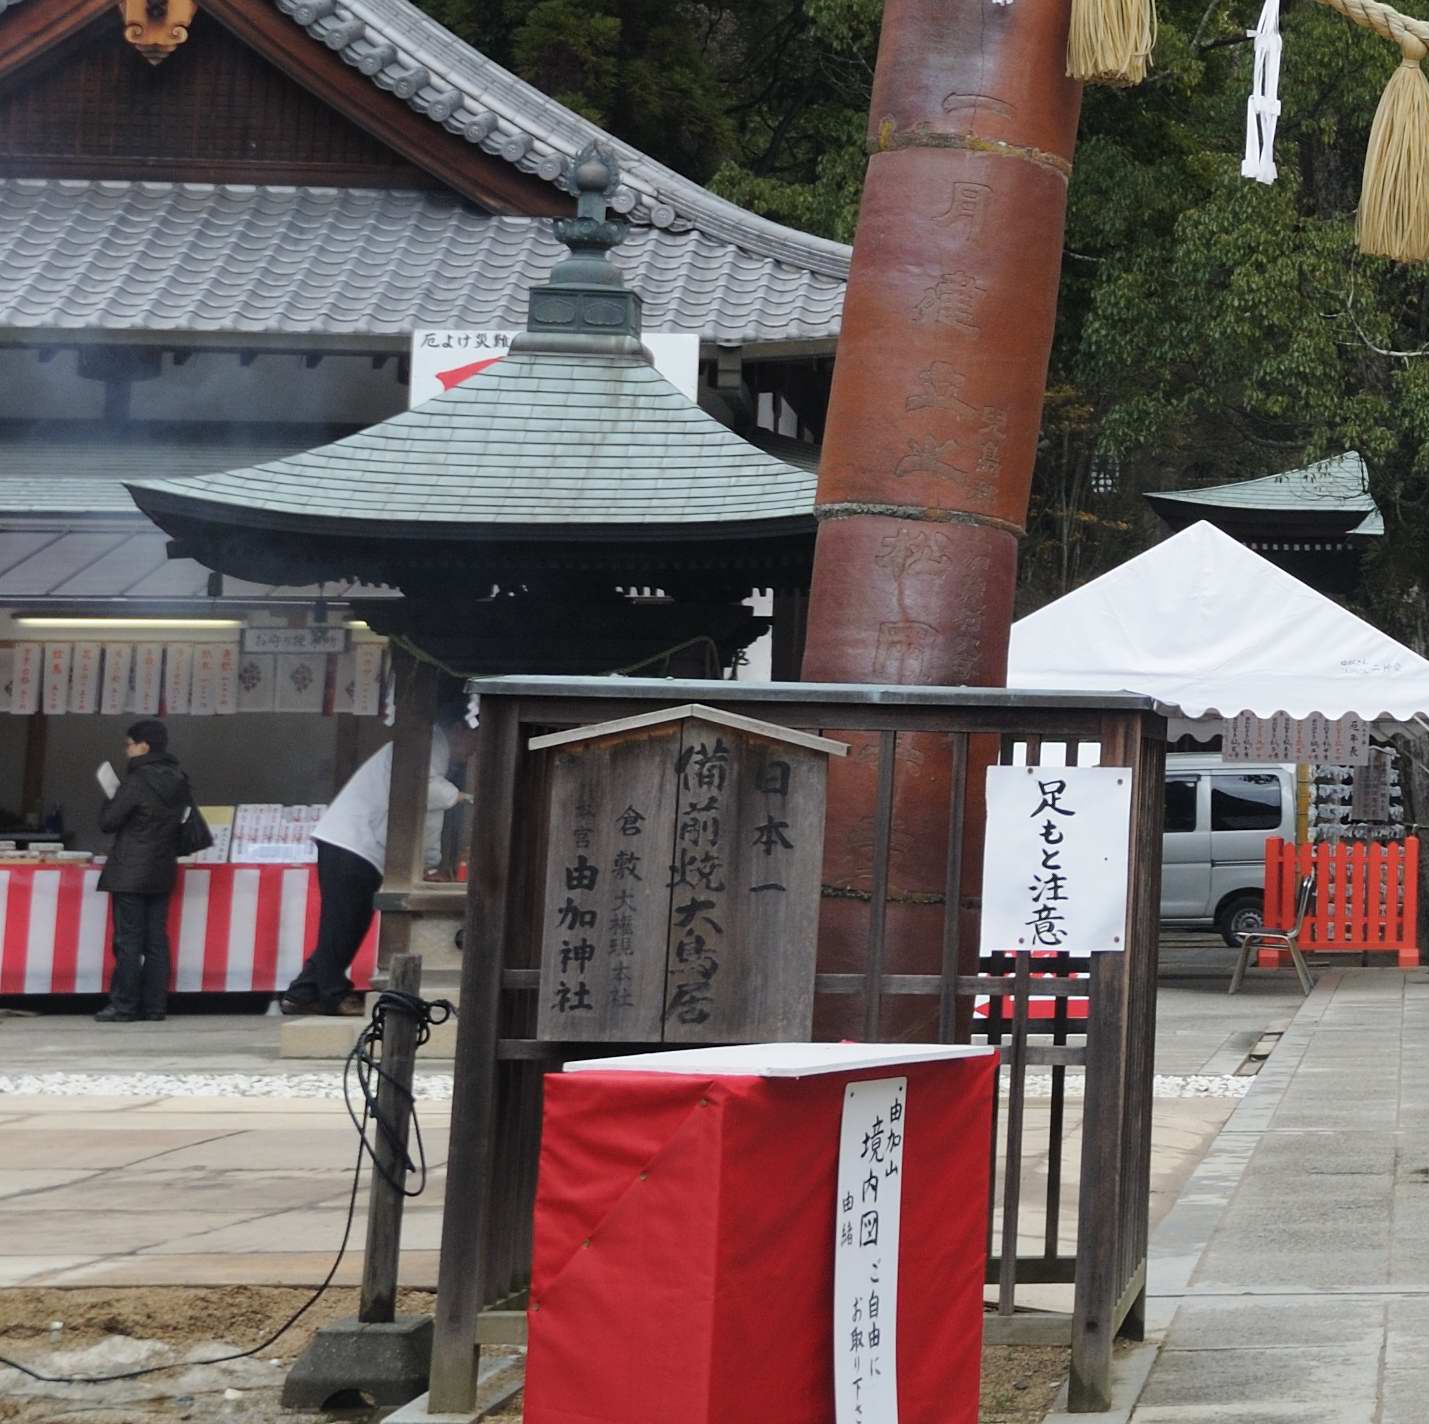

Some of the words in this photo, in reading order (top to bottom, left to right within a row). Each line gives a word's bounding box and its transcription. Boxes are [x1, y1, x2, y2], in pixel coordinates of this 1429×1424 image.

[664, 738, 731, 1025] 備前焼大鳥居
[748, 760, 795, 895] 日本一
[1024, 779, 1076, 947] 足もと注意
[858, 1113, 888, 1248] 境内図
[884, 1096, 904, 1178] 由加山
[867, 1257, 882, 1377] ご自由に
